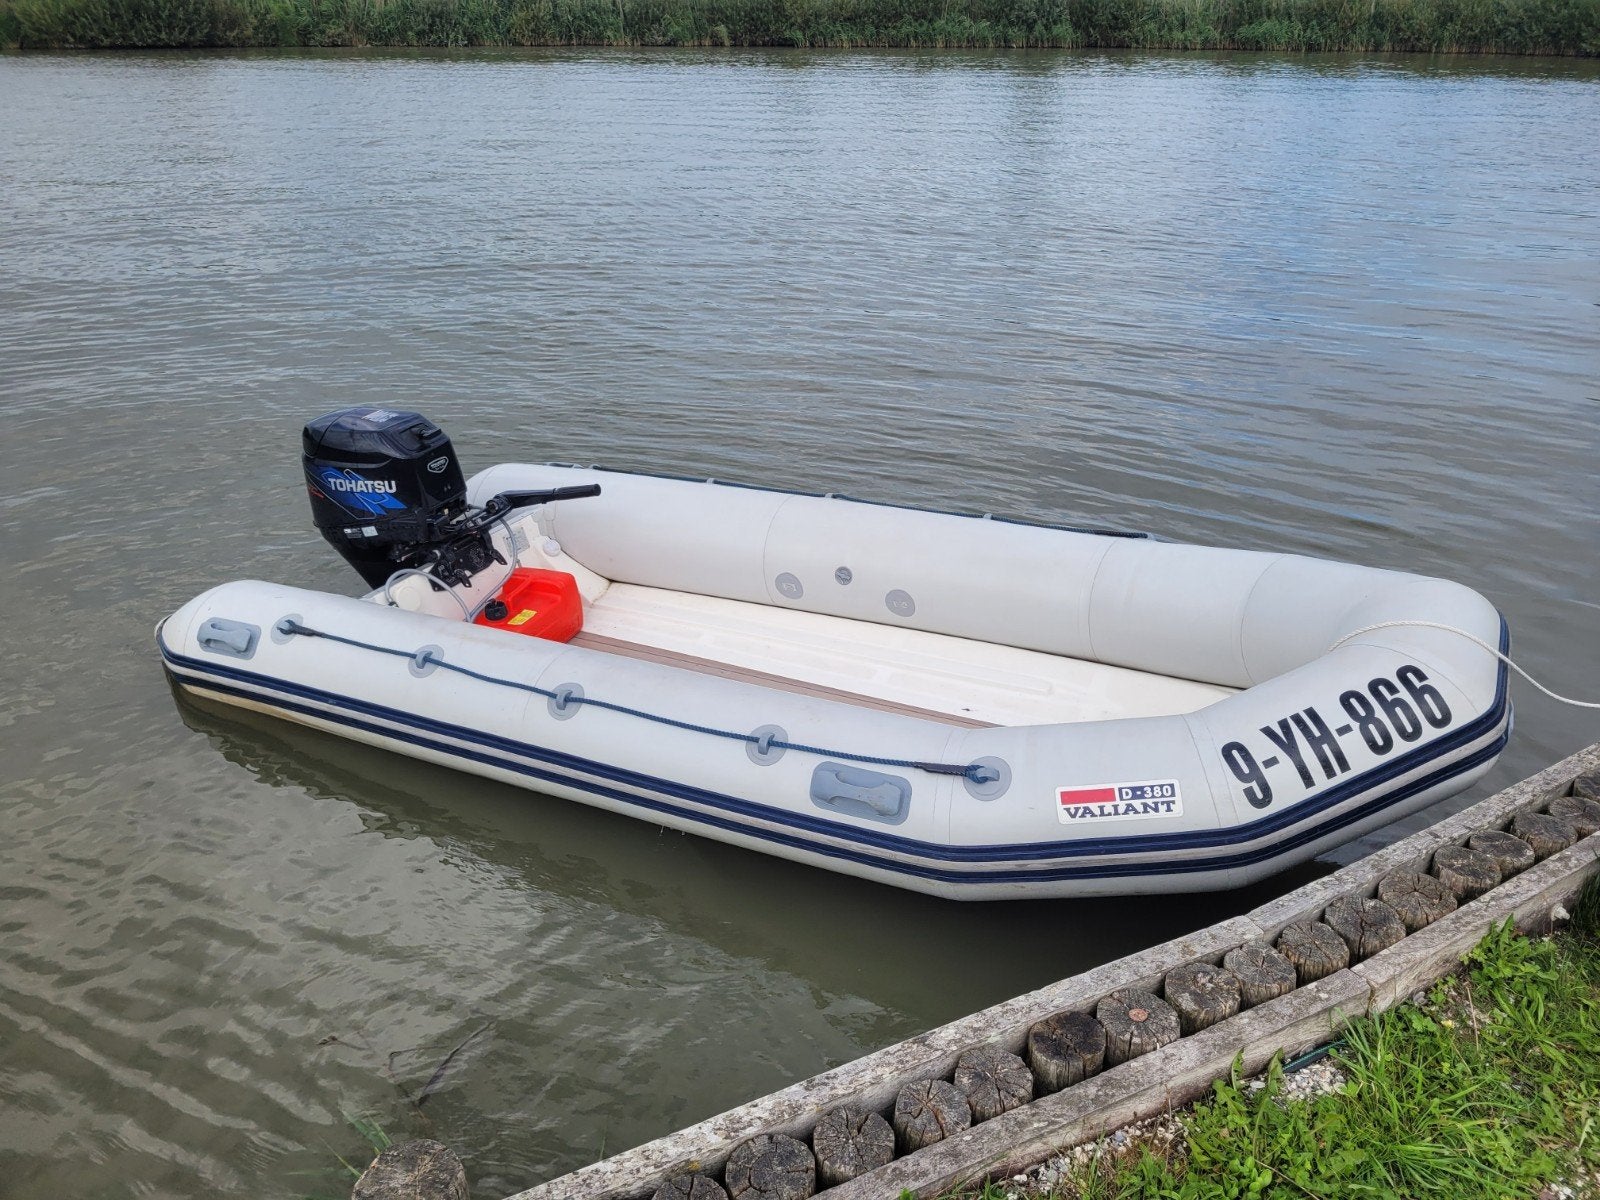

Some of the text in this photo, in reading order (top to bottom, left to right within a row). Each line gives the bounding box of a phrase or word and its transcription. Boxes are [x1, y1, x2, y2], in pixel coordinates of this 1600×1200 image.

[328, 477, 397, 494] TOHATSU
[1221, 664, 1453, 810] 9-YH-866
[1063, 799, 1176, 819] VALIANT
